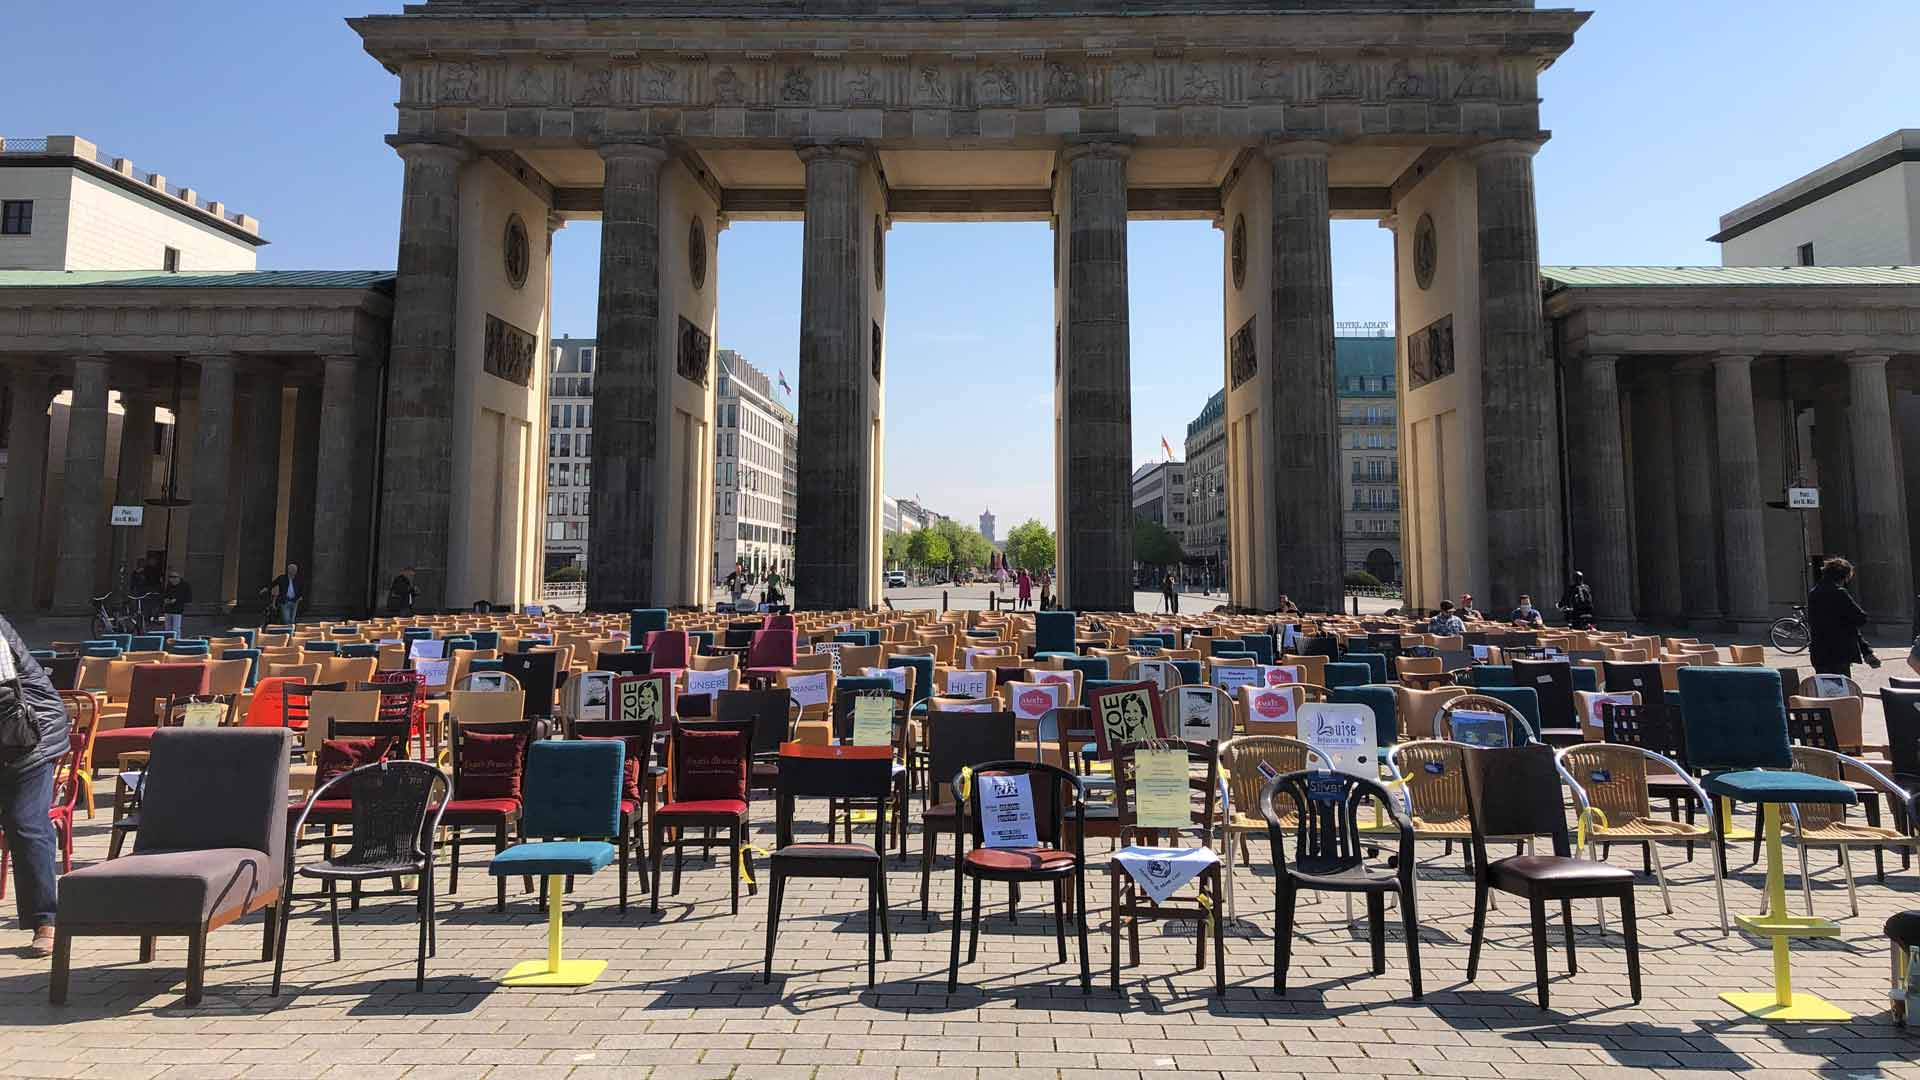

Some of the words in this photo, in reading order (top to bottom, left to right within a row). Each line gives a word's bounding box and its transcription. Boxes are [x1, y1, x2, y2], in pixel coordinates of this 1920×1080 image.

[1336, 321, 1361, 329] HOTEL
[1363, 321, 1388, 329] ADLON
[690, 679, 726, 689] UNSERE
[951, 682, 984, 693] HILFE
[623, 683, 637, 720] ZOE
[1103, 695, 1126, 741] ZOE
[1316, 712, 1357, 736] Louise
